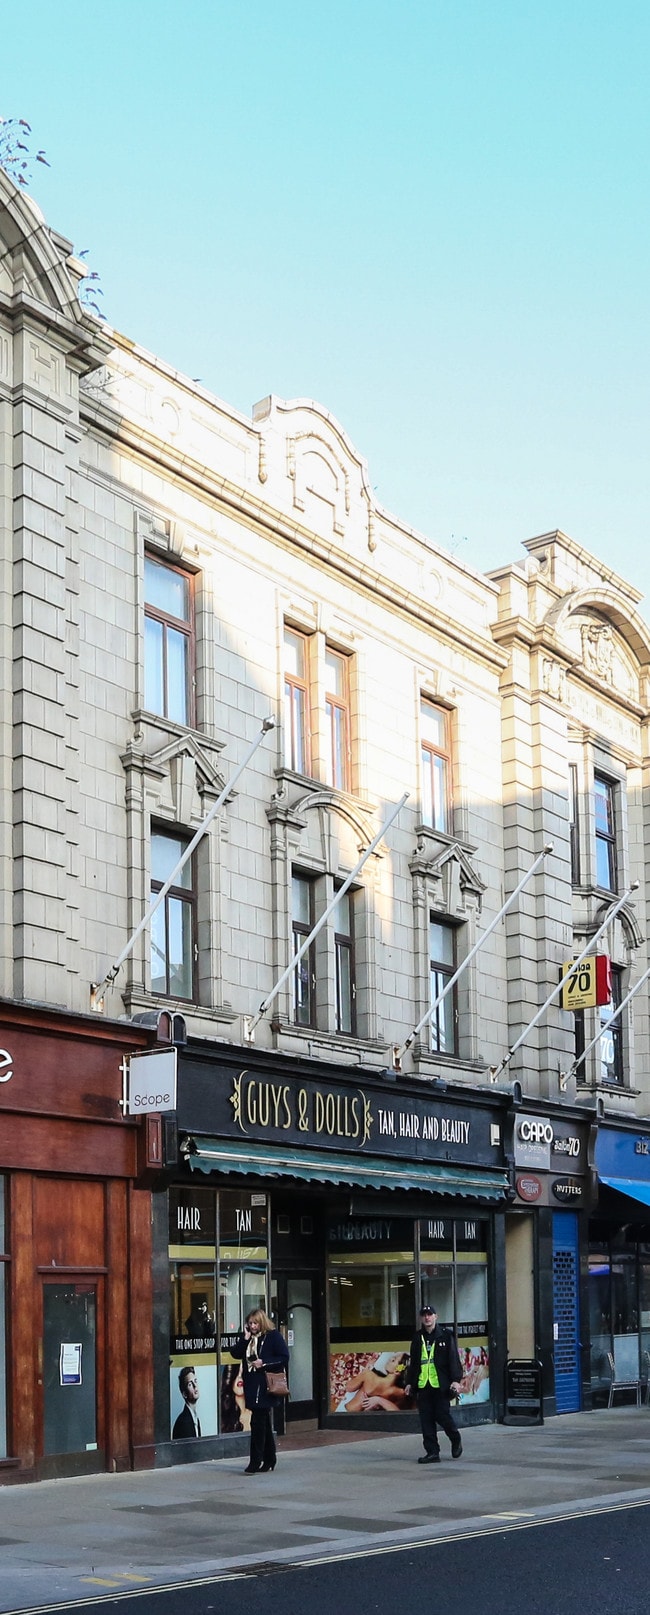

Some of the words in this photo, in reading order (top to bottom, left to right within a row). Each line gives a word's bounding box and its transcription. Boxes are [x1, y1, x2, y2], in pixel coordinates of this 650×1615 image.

[567, 963, 591, 973] Slon
[567, 972, 591, 994] 70
[134, 1093, 170, 1107] Scope
[247, 1080, 291, 1129] GUYS
[298, 1088, 310, 1132] &
[315, 1091, 359, 1138] DOLLS
[378, 1109, 397, 1139] TAN,
[399, 1112, 420, 1138] HAIR
[422, 1116, 439, 1141] AND
[441, 1118, 470, 1145] BEAUTY
[520, 1120, 554, 1144] CAPO
[568, 1137, 580, 1157] 70
[177, 1206, 201, 1231] HAIR
[235, 1209, 252, 1232] TAN
[428, 1220, 445, 1239] HAIR
[464, 1221, 476, 1239] TAN
[175, 1339, 184, 1350] THE
[183, 1338, 193, 1350] ONE
[193, 1338, 204, 1349] STOP
[204, 1337, 216, 1349] SHOP
